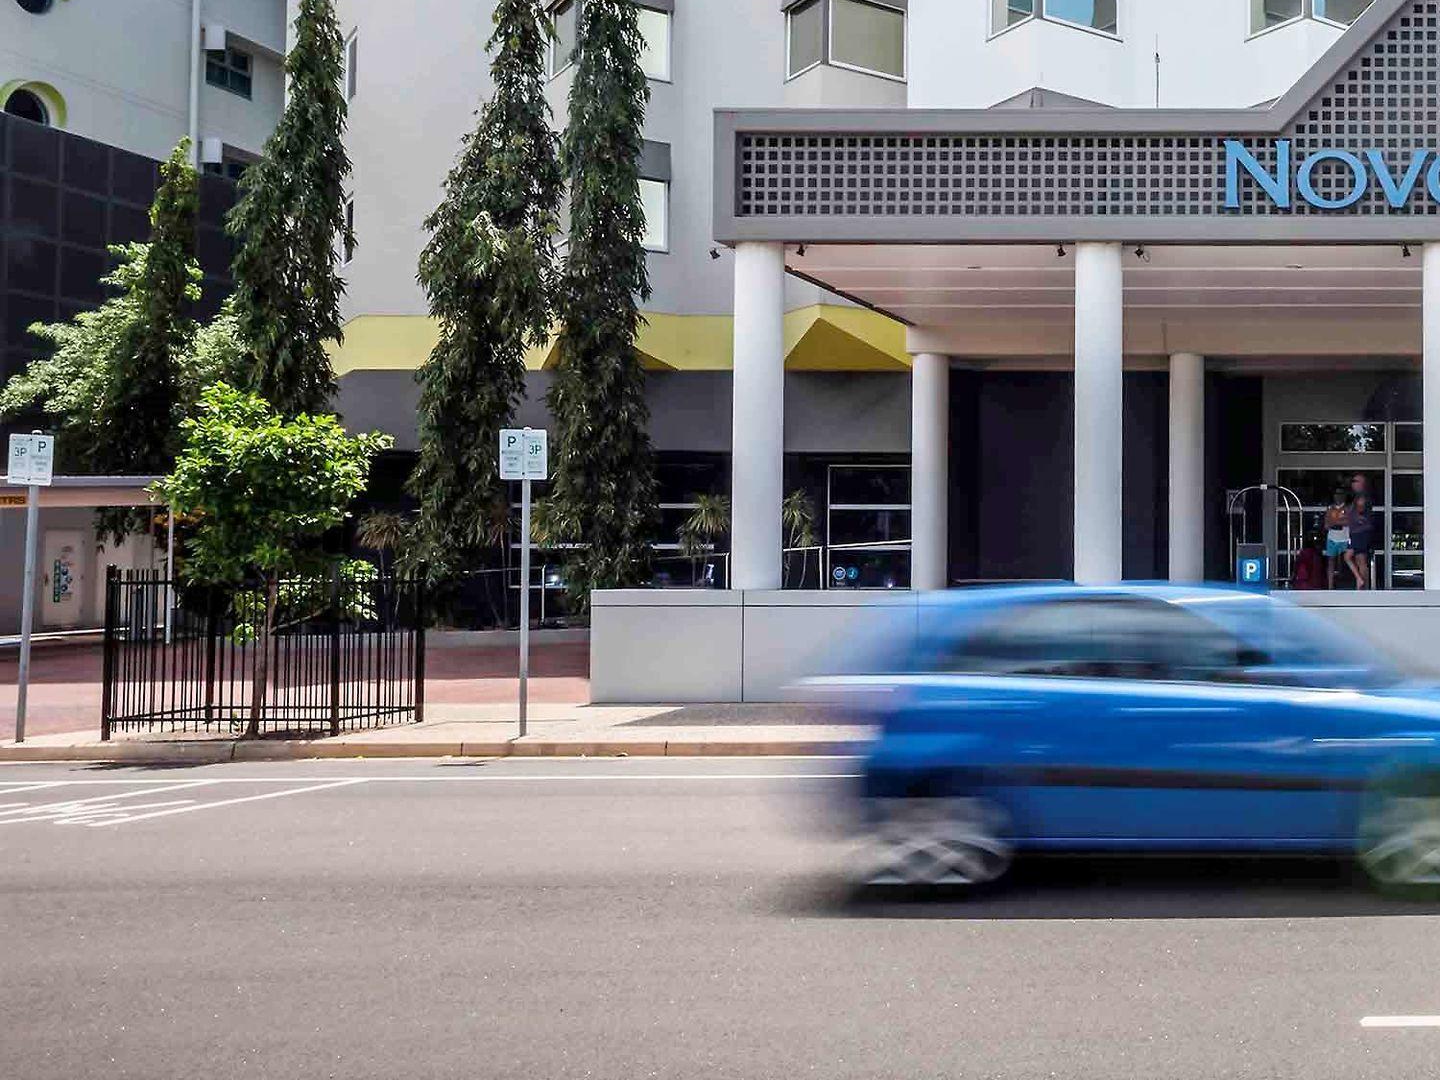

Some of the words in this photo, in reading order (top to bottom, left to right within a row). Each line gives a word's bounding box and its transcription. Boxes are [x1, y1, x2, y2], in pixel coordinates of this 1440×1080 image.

[38, 441, 46, 452] P
[507, 436, 516, 447] P
[529, 444, 542, 455] 3P
[1246, 562, 1257, 579] P
